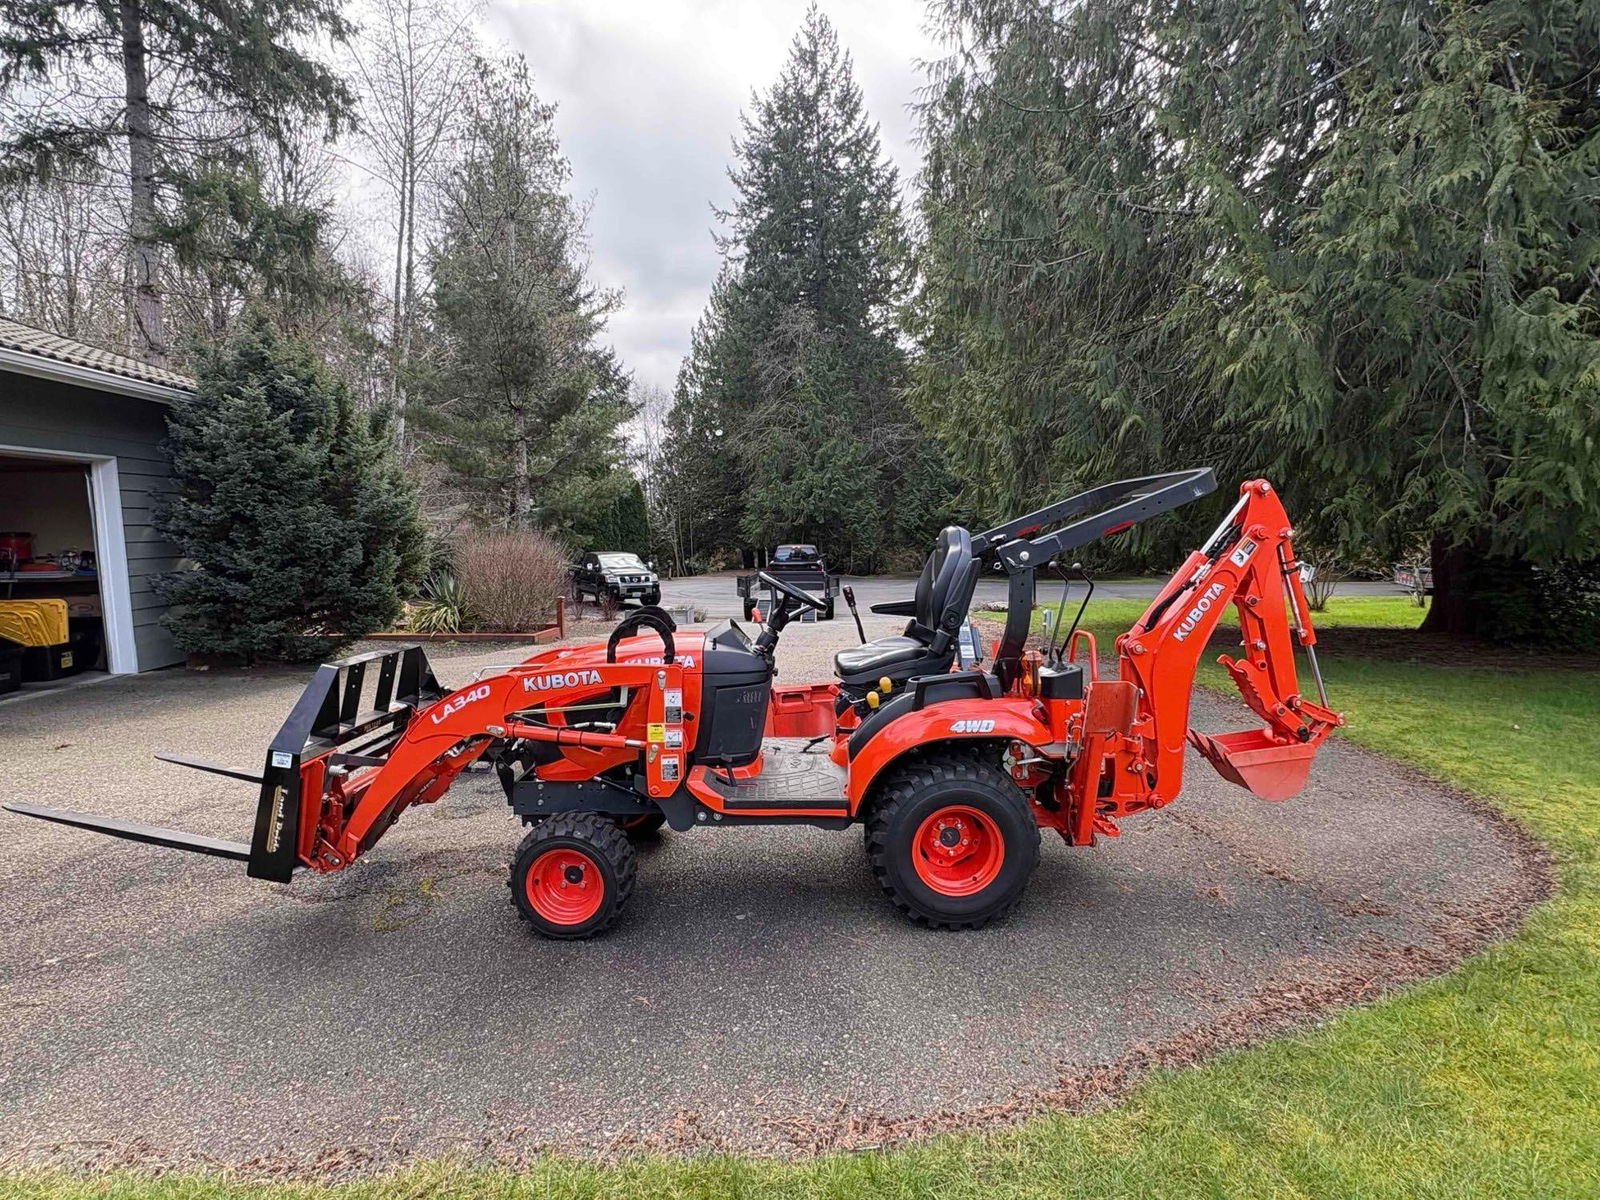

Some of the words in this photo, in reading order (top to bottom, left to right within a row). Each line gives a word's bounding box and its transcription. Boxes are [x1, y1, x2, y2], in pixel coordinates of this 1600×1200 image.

[1173, 582, 1226, 642] KUBOTA
[624, 655, 696, 669] UBTA
[523, 669, 603, 692] KUBOTA
[431, 684, 491, 724] LA340
[949, 719, 996, 734] 4WD
